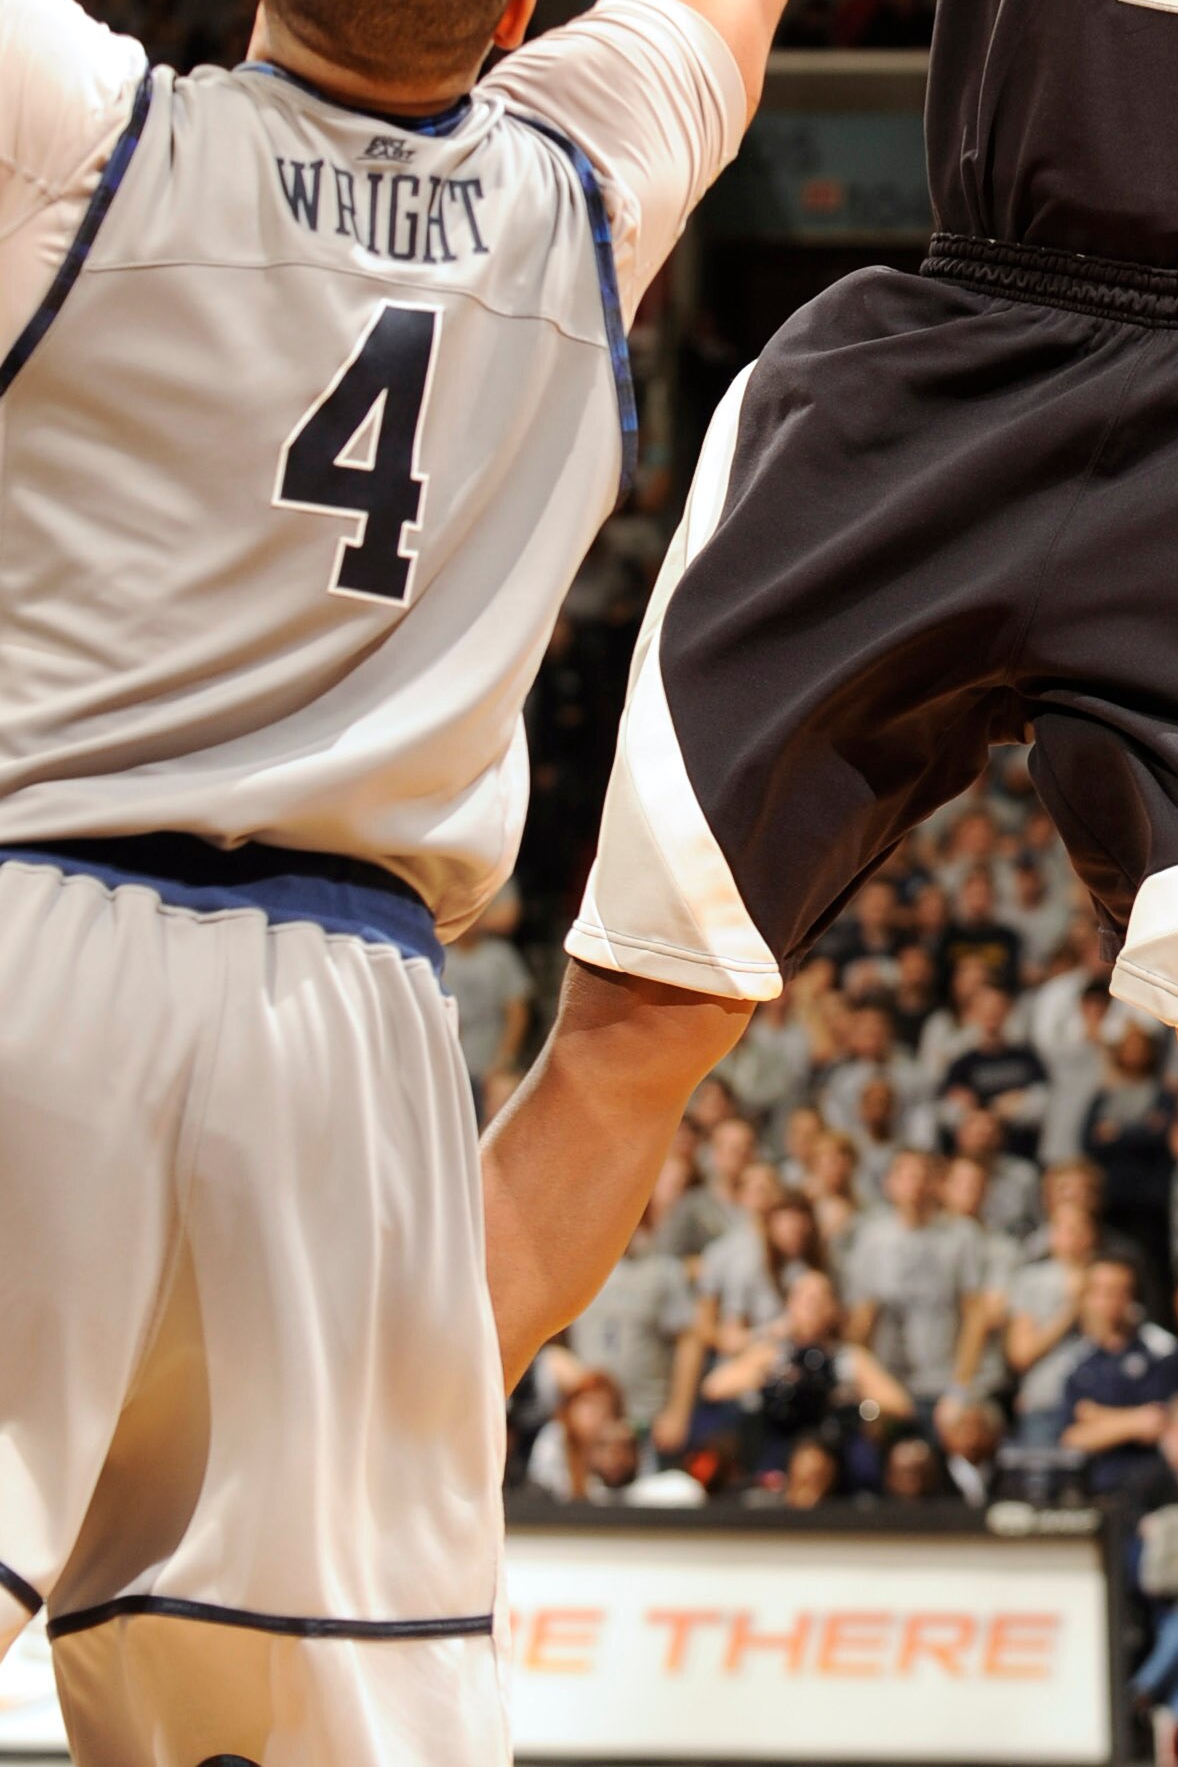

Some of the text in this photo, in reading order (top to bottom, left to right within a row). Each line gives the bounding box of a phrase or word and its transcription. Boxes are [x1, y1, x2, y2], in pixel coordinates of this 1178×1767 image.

[276, 156, 490, 264] WRIGHT
[272, 298, 444, 608] 4
[643, 1607, 1060, 1680] THERE
